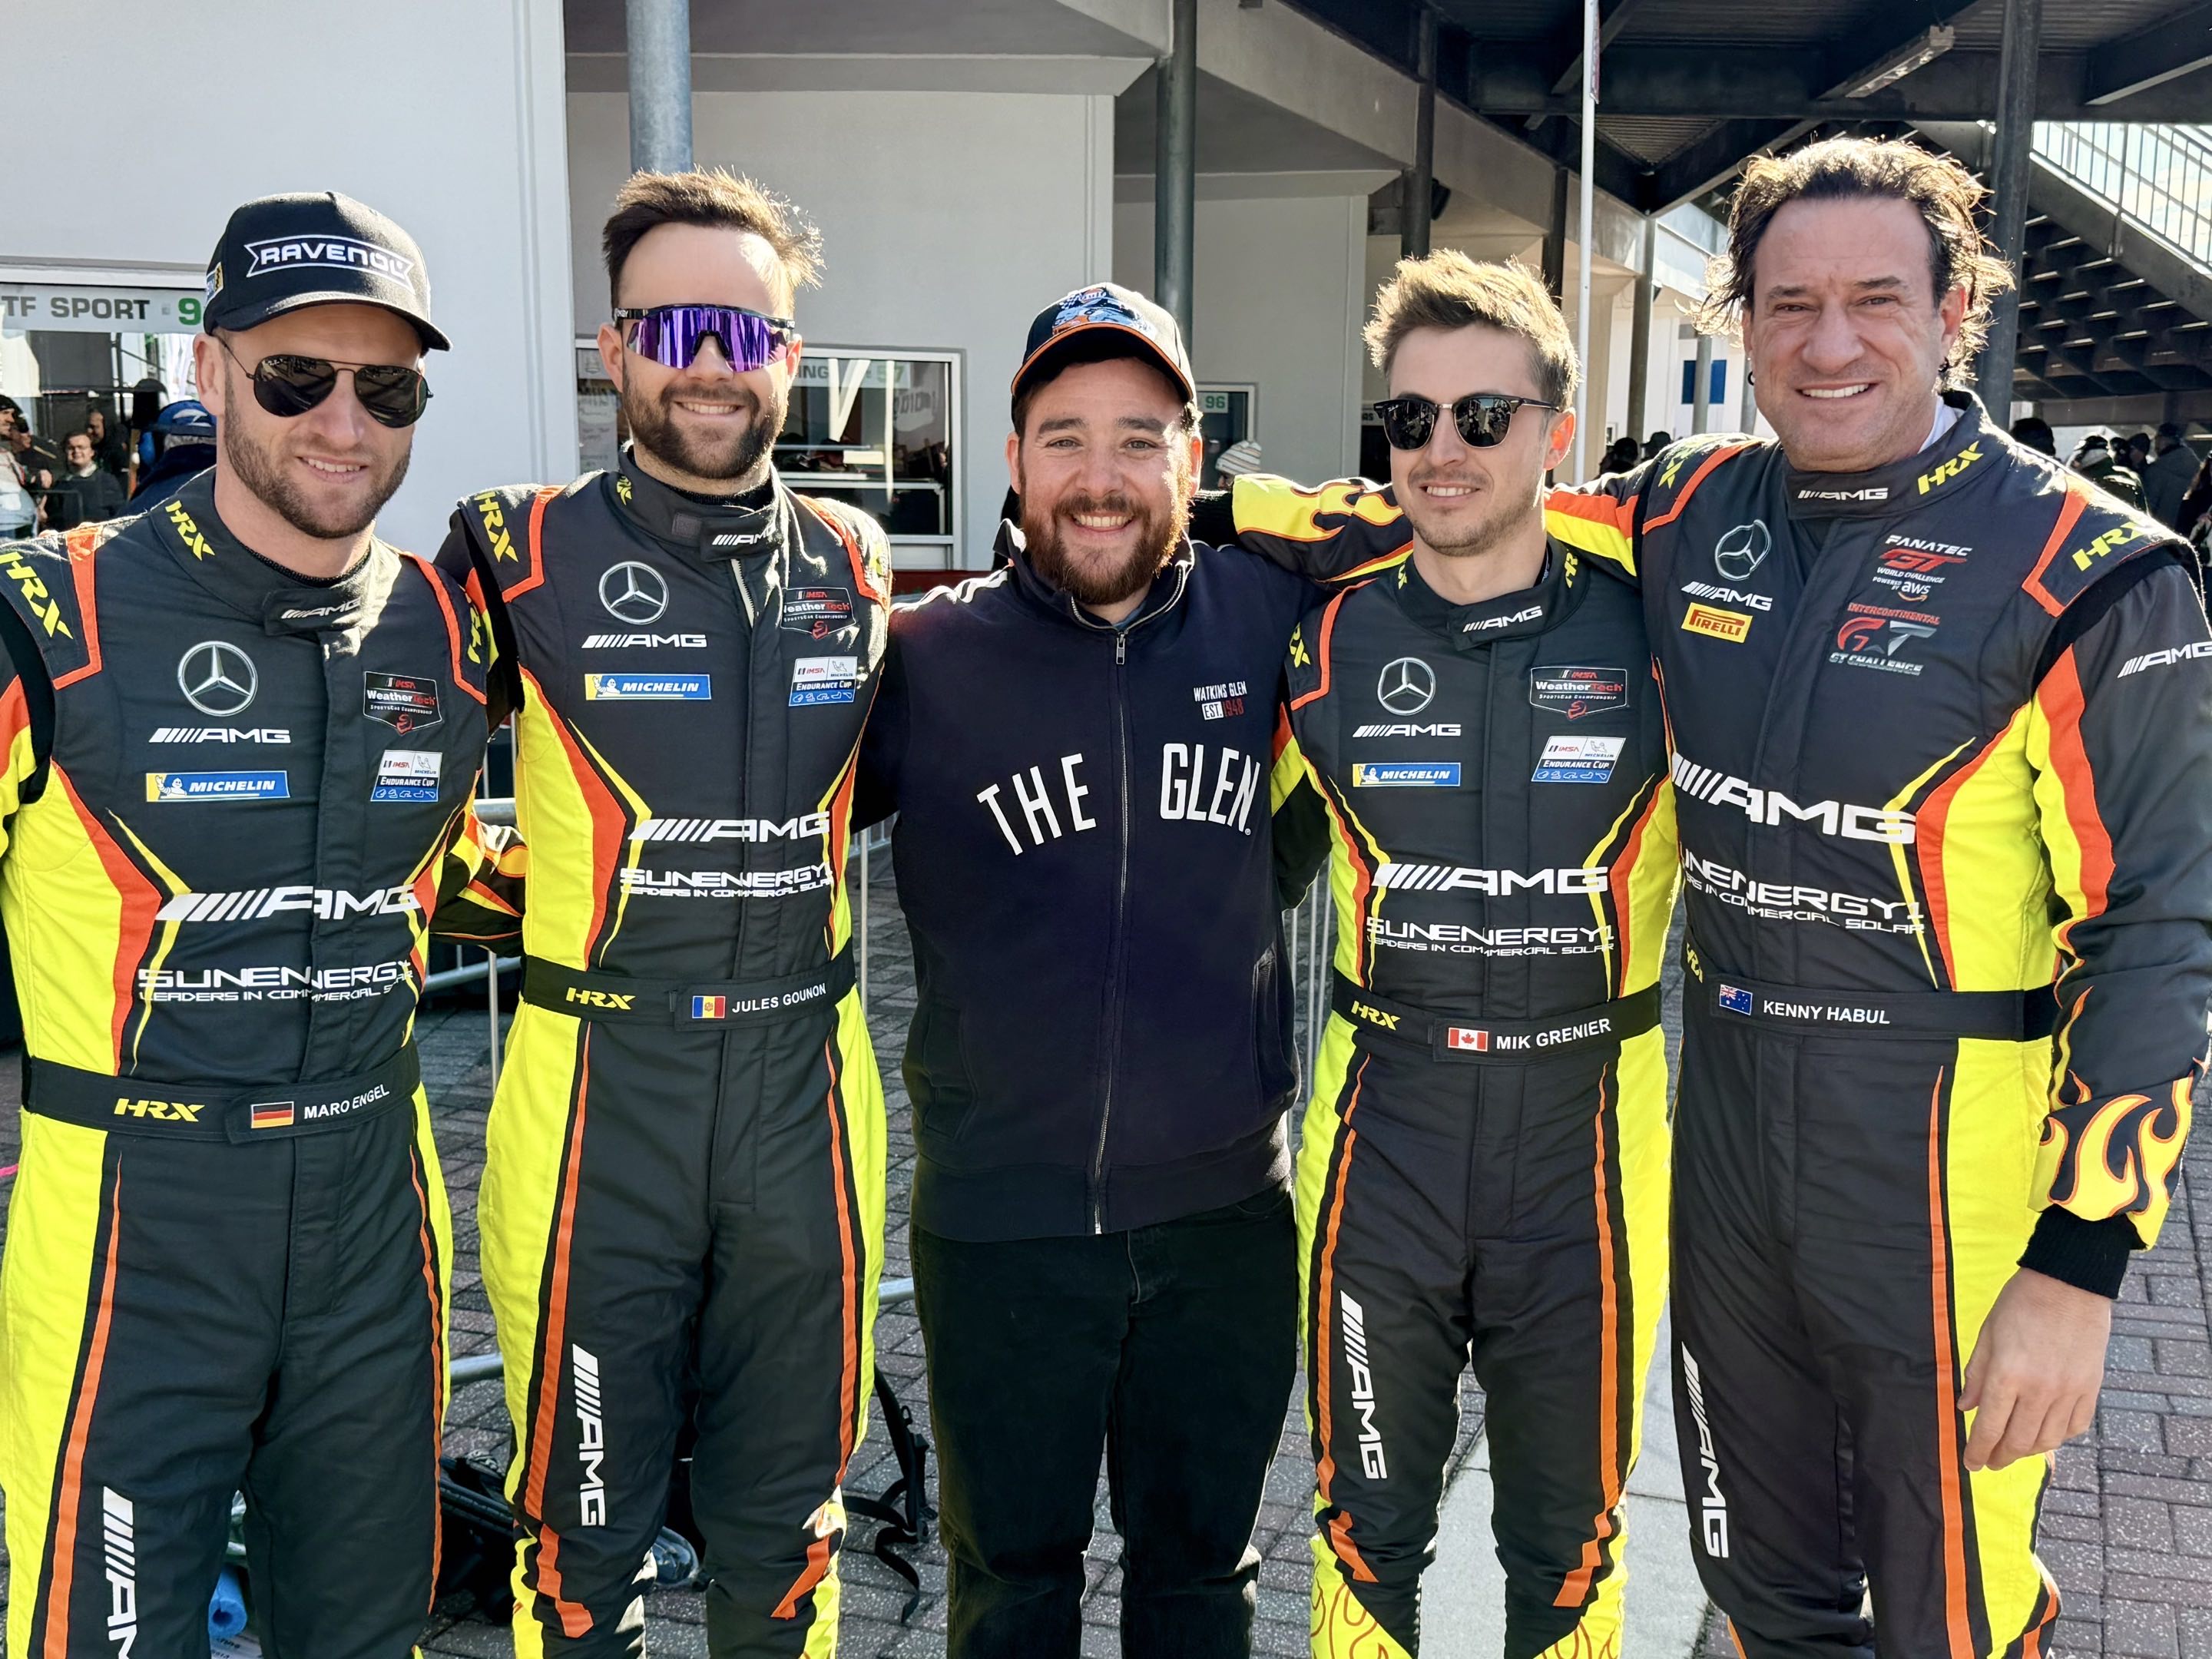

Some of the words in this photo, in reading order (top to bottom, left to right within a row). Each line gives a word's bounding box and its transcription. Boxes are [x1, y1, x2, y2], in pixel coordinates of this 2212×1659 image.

[260, 242, 406, 278] RAVENOL
[2, 296, 36, 316] TF
[51, 296, 150, 320] SPORT
[798, 365, 830, 379] ING
[1205, 396, 1226, 409] 96
[1918, 440, 1984, 495] HRX
[1819, 488, 1889, 501] AMG
[165, 500, 215, 561] HRX
[475, 491, 519, 563] HRX
[1886, 535, 1972, 557] FANATEC
[1879, 548, 1967, 572] GT
[1872, 576, 1902, 586] POWERED
[1876, 567, 1903, 578] WORLD
[1904, 571, 1945, 584] CHALLENGE
[1901, 581, 1931, 594] aws
[0, 551, 74, 639] HRX
[1710, 587, 1773, 611] AMG
[1482, 606, 1543, 630] AMG
[1689, 609, 1746, 637] PIRELLI
[1847, 602, 1941, 625] INTERCONTINENTAL
[624, 634, 707, 647] AMG
[1289, 621, 1311, 669] RX
[1829, 652, 1849, 664] GT
[1847, 654, 1924, 676] CHALLENGE
[2137, 641, 2212, 672] AMG
[621, 681, 700, 693] MICHELIN
[796, 682, 839, 691] ENDURANCE
[839, 680, 853, 689] CUP
[1194, 684, 1228, 702] WATKINS
[1229, 680, 1247, 697] GLEN
[1536, 681, 1623, 692] WeatherTech
[1223, 698, 1244, 717] 1948
[201, 728, 291, 743] AMG
[1388, 724, 1461, 737] AMG
[1380, 769, 1452, 780] MICHELIN
[1542, 760, 1592, 768] ENDURANCE
[1592, 760, 1610, 769] CUP
[189, 780, 276, 793] MICHELIN
[380, 777, 422, 786] ENDURANCE
[422, 778, 435, 787] CUP
[976, 753, 1097, 856] THE
[1160, 743, 1260, 833] GLEN
[1707, 775, 1916, 844] AMG
[700, 811, 830, 843] AMG
[620, 886, 691, 897] LEADERS
[694, 888, 708, 897] IN
[1438, 866, 1609, 896] AMG
[1684, 848, 1926, 920] NENERGY1
[252, 884, 422, 920] AMG
[1366, 916, 1614, 946] SUNENERGY1
[1846, 919, 1926, 935] SOLAR
[1366, 935, 1428, 952] LEADERS
[1431, 942, 1446, 952] IN
[1561, 942, 1614, 955] SOLAR
[139, 991, 240, 1002] LEADERS
[243, 991, 263, 1001] IN
[566, 987, 637, 1011] HRX
[731, 996, 779, 1014] JULES
[782, 983, 826, 1005] GOUNON
[1350, 1000, 1401, 1031] HRX
[1763, 1000, 1823, 1022] KENNY
[1826, 1005, 1891, 1025] HABUL
[1495, 1034, 1532, 1051] MIK
[1535, 1018, 1611, 1048] GRENIER
[114, 1098, 205, 1123] HRX
[303, 1099, 351, 1120] MARO
[352, 1084, 390, 1108] ENGEL
[1346, 1353, 1388, 1479] AMG
[577, 1407, 606, 1527] AMG
[1690, 1407, 1730, 1558] AMG
[106, 1567, 137, 1659] AM
